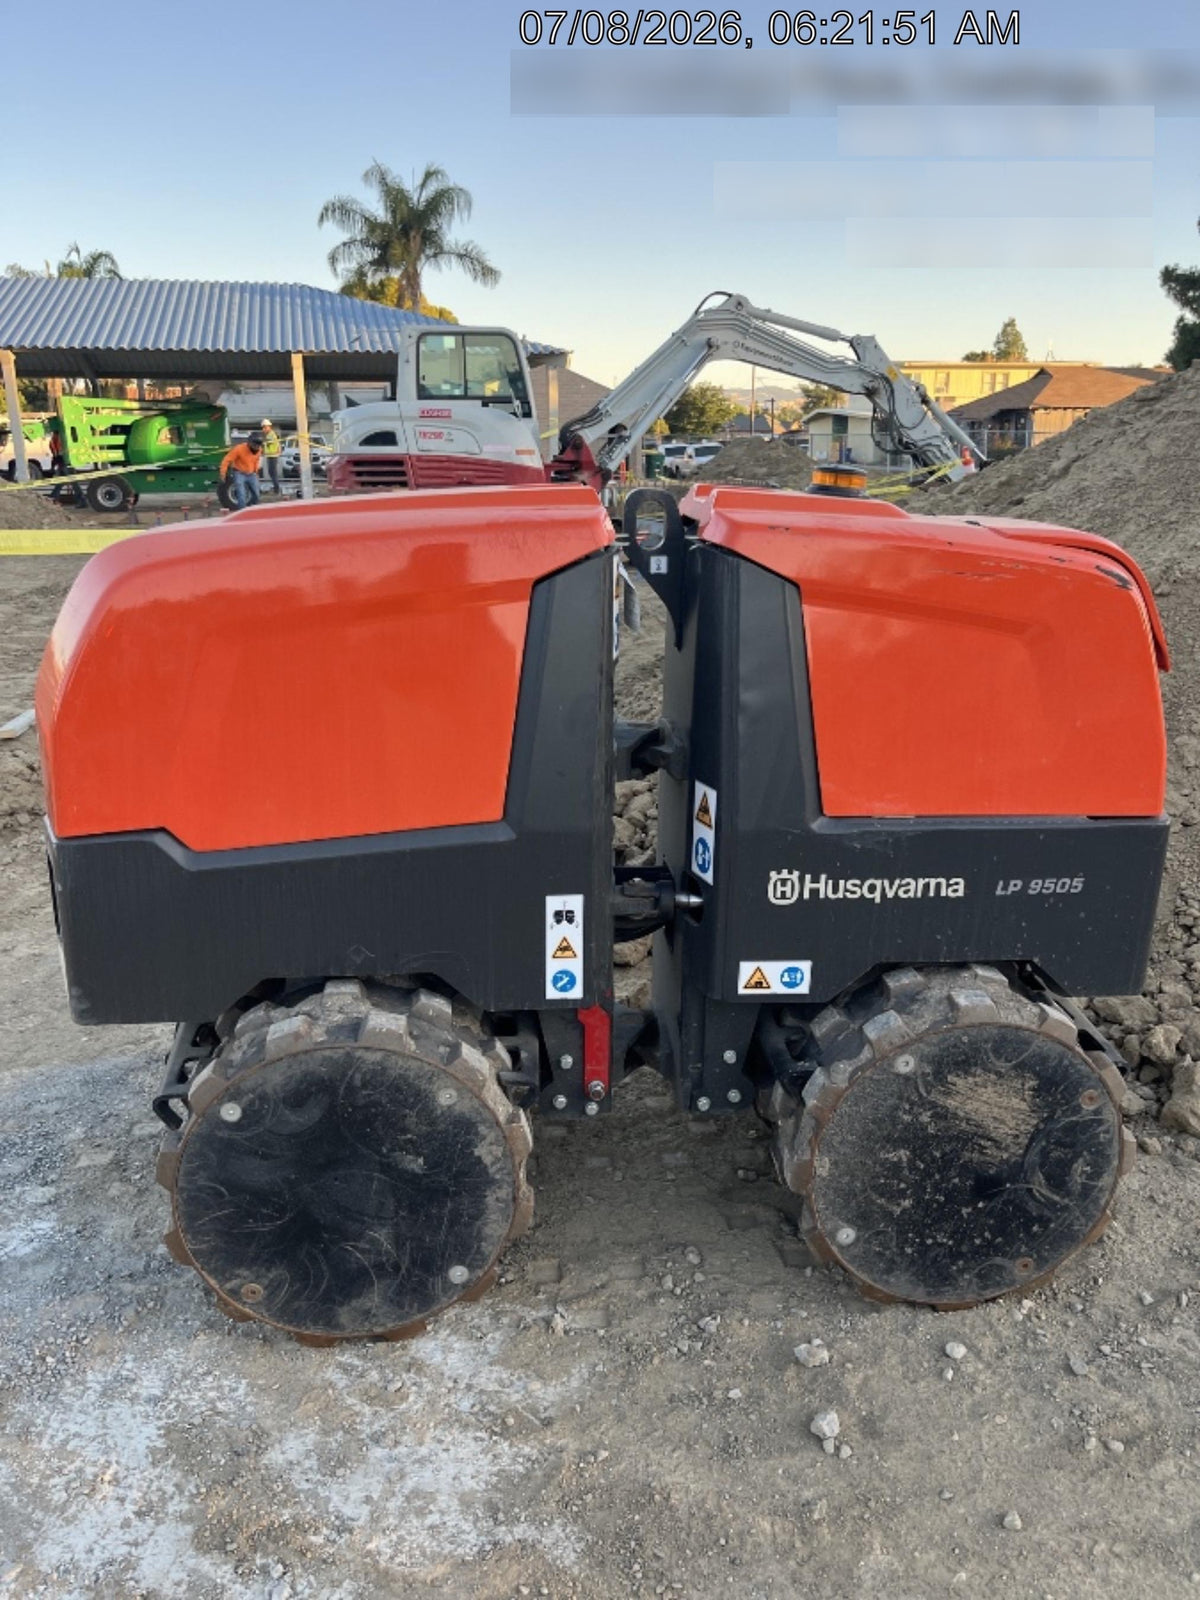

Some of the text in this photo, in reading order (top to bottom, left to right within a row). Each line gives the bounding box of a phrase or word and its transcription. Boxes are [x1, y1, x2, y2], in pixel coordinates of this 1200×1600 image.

[803, 874, 965, 903] Husqvarna
[995, 877, 1086, 896] LP 9505
